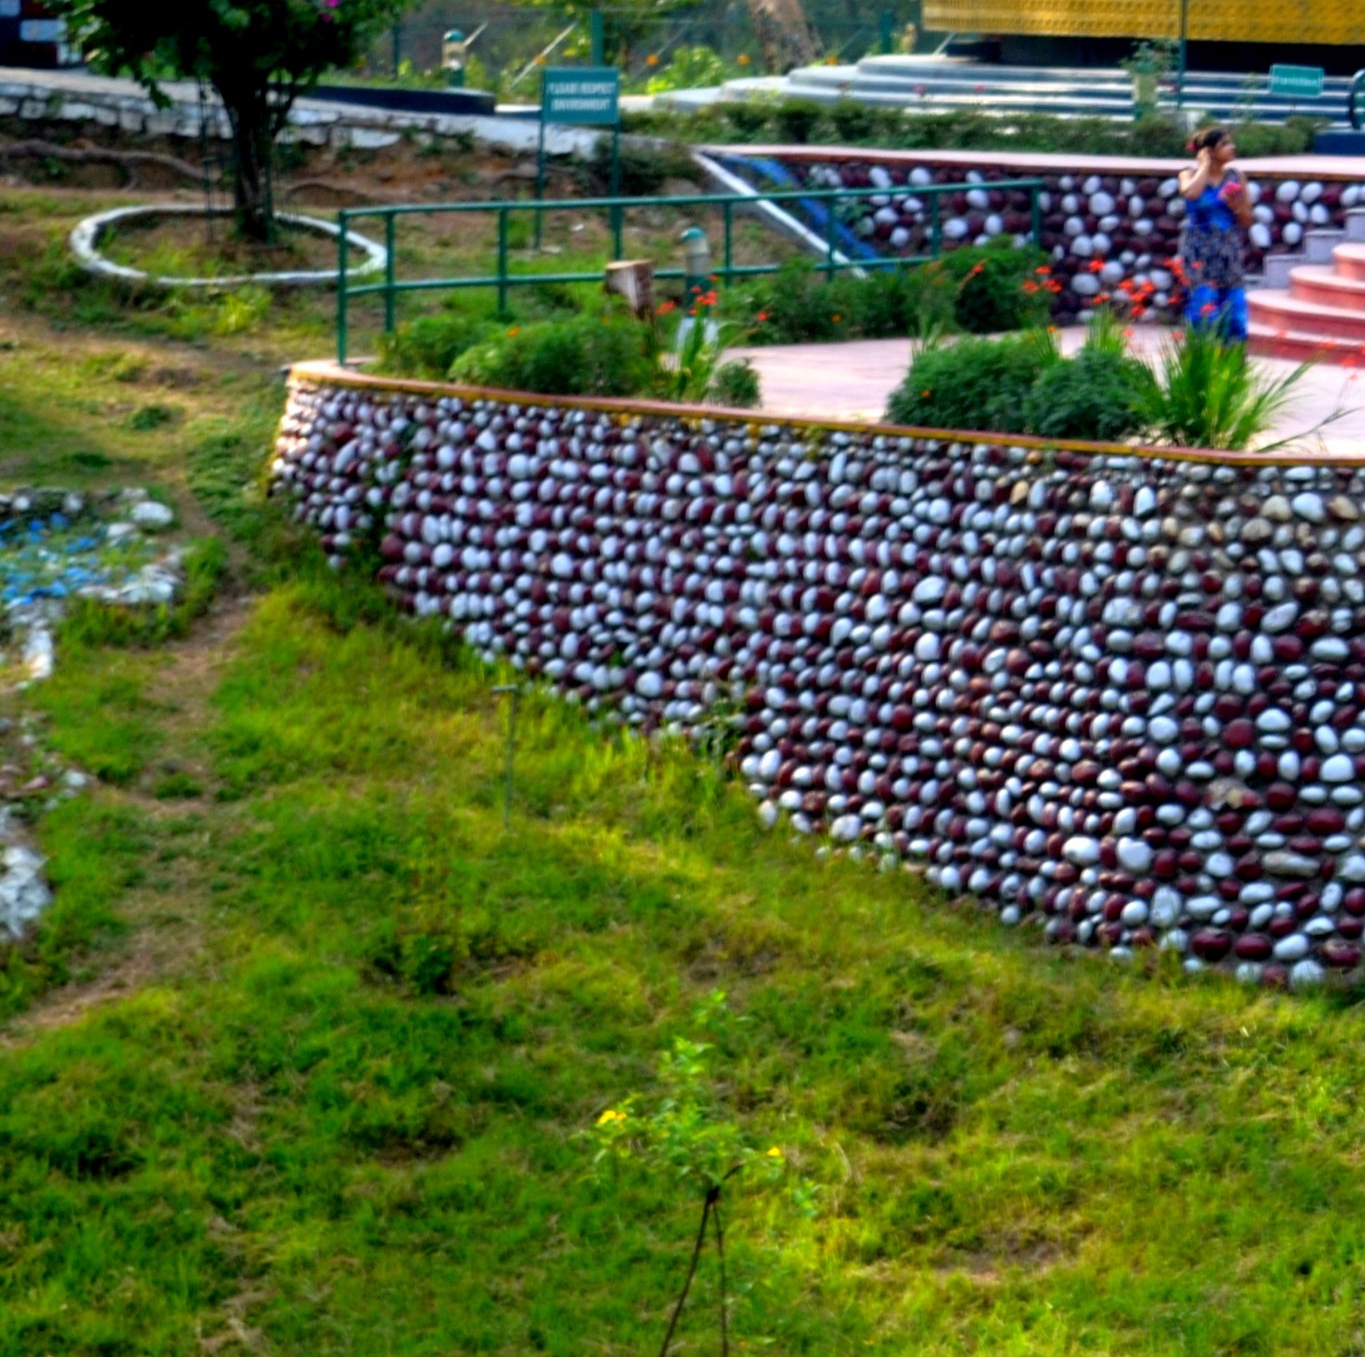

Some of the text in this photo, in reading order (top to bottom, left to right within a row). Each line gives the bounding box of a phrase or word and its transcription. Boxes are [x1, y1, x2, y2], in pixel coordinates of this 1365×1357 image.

[547, 81, 616, 94] PLEASE RESPECT
[551, 99, 610, 111] ENVIRONMENT
